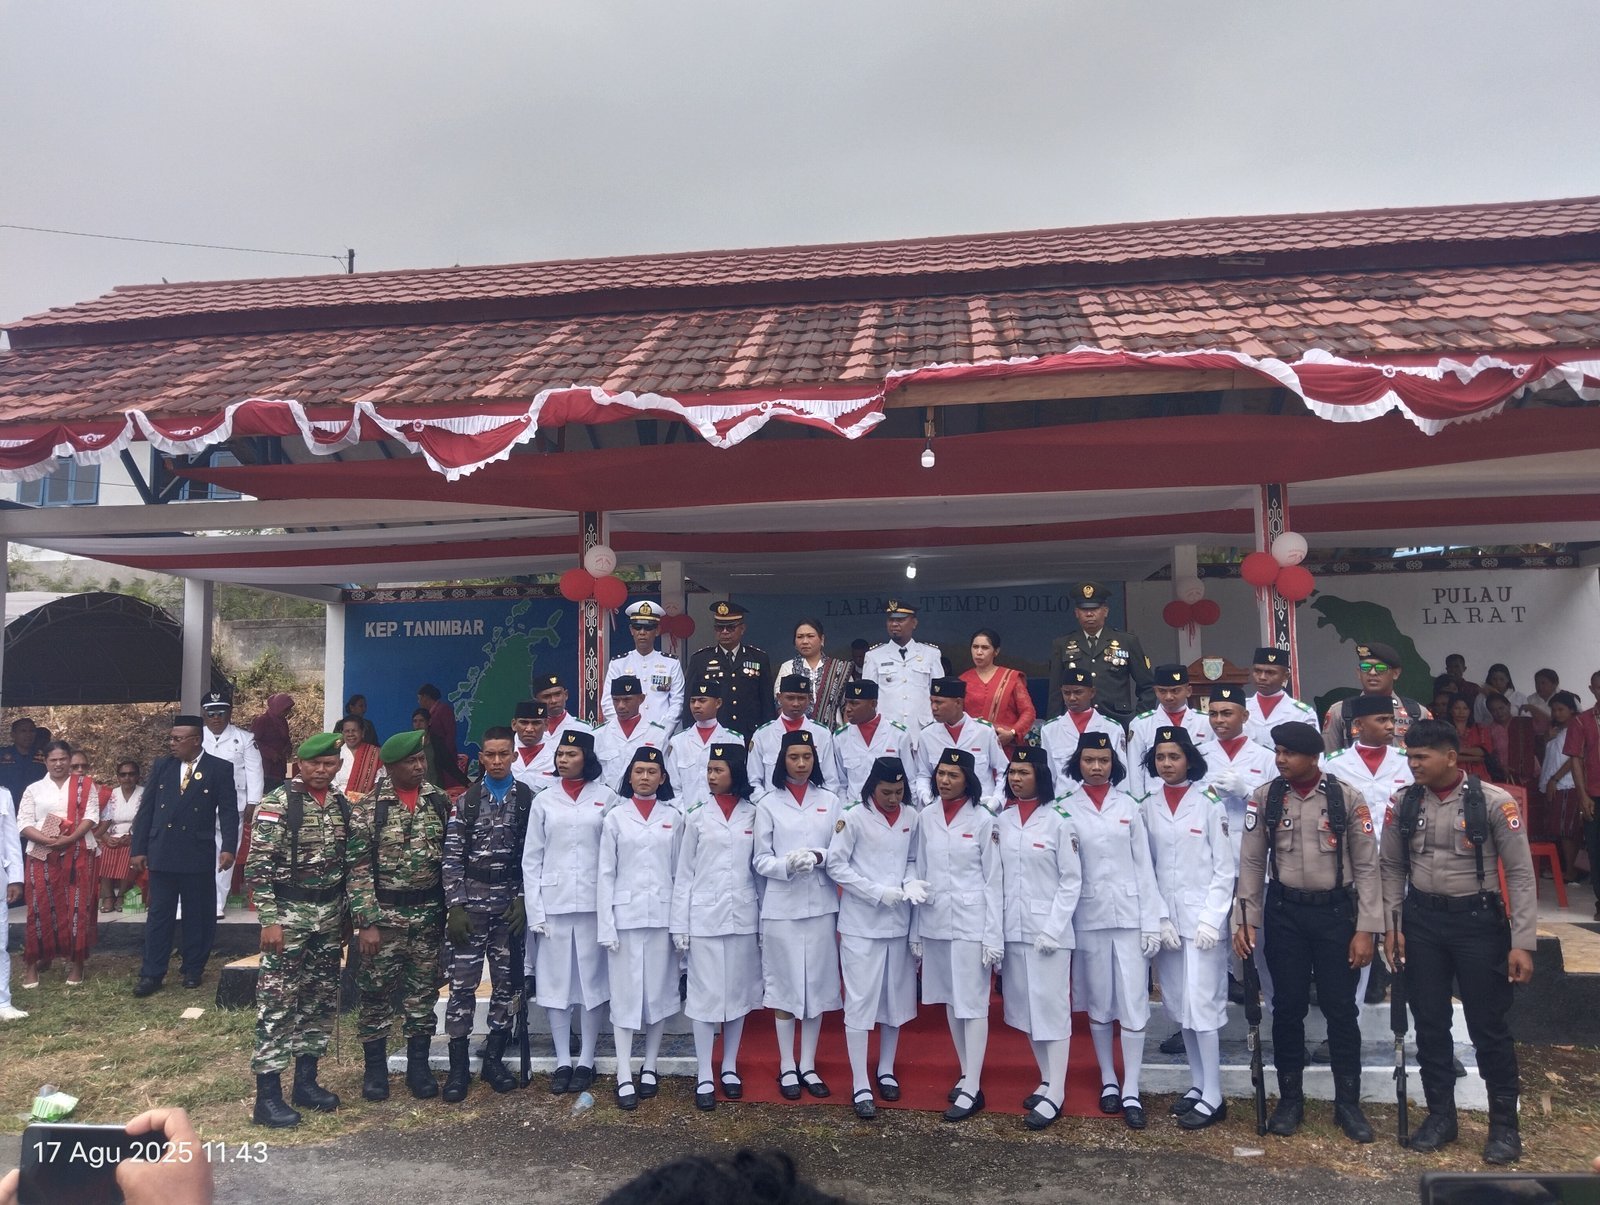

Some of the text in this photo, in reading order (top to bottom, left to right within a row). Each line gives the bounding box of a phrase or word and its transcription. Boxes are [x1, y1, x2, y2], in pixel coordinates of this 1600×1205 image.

[1431, 586, 1513, 605] PULAU
[824, 594, 1071, 617] LARA TEMPO DOLO
[1421, 606, 1527, 625] LARAT
[403, 619, 485, 637] TANIMBAR
